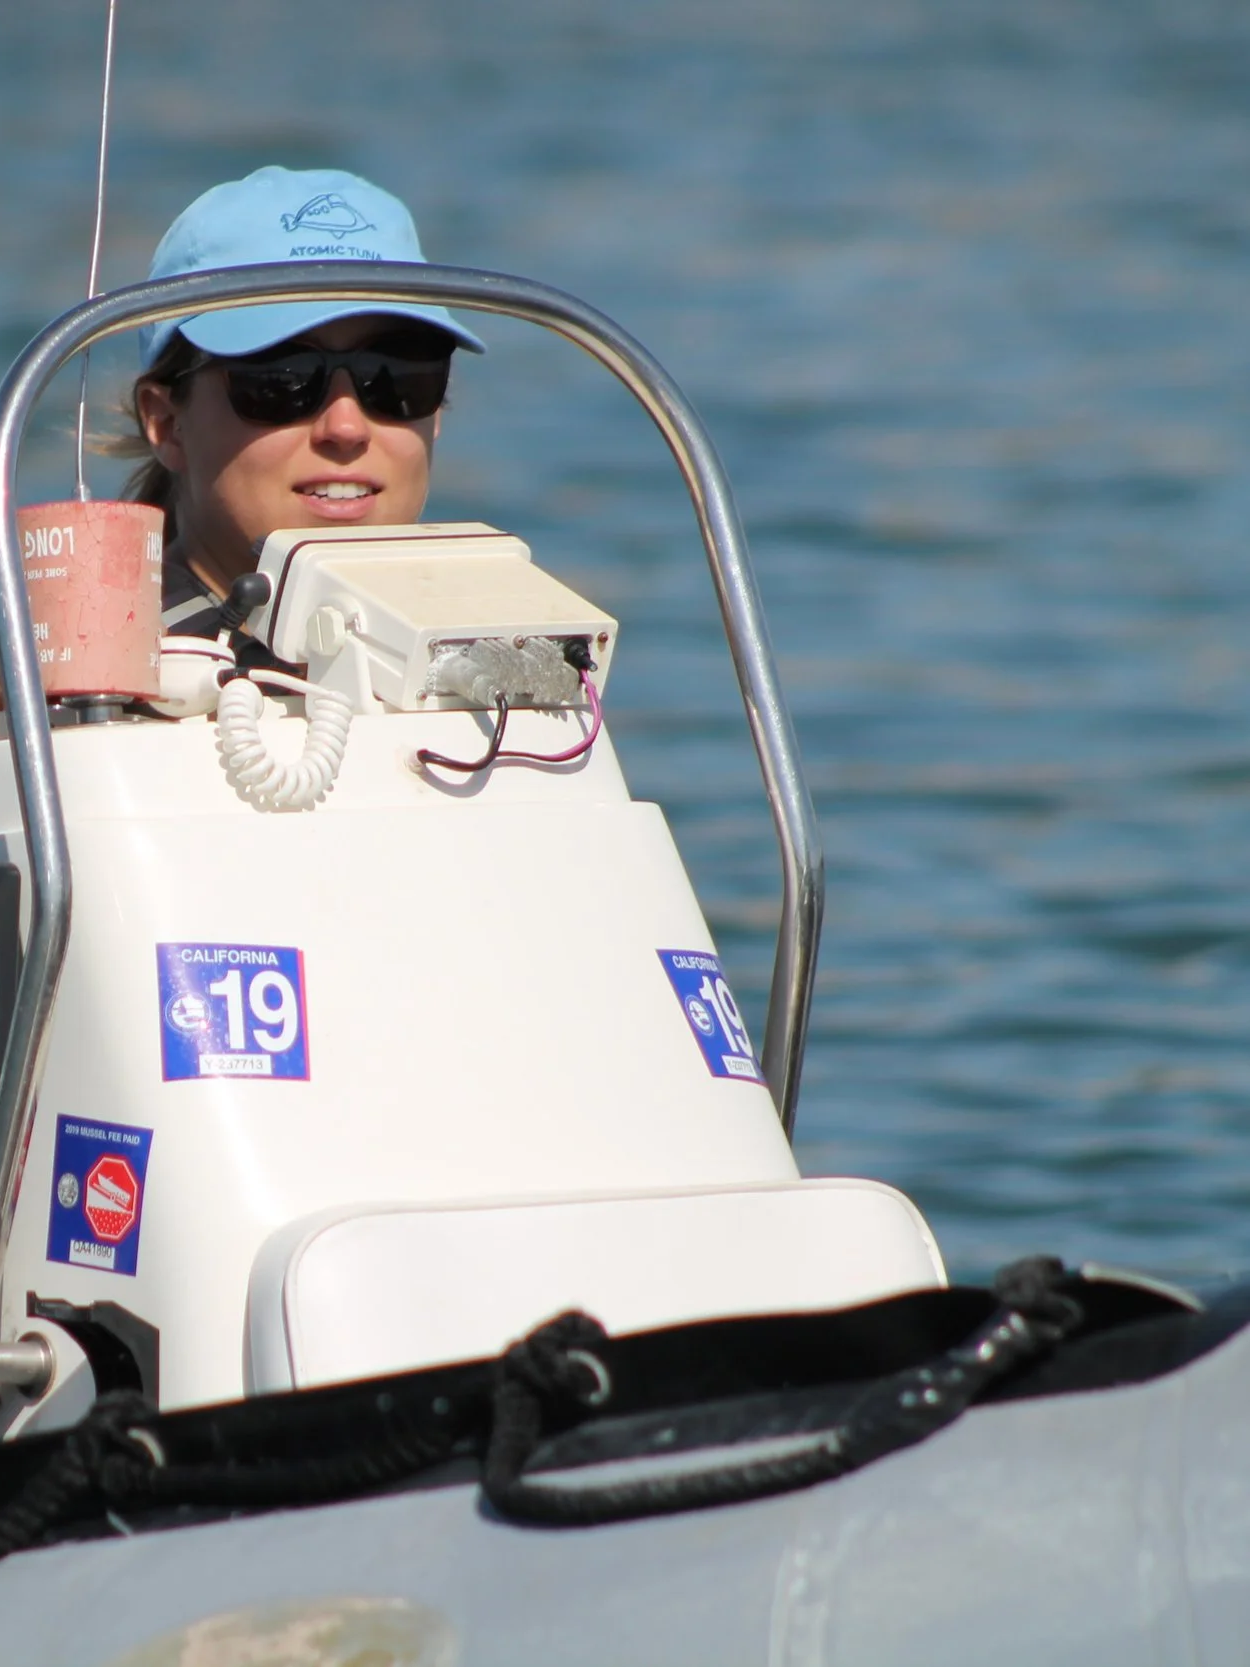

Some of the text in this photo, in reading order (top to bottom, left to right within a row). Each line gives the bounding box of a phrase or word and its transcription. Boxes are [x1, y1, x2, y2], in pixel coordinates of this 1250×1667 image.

[290, 246, 383, 260] ATOMIC TUNA
[25, 526, 74, 559] LONG
[45, 566, 67, 578] SOME
[59, 648, 71, 661] IF
[181, 949, 278, 965] CALIFORNIA
[210, 970, 298, 1052] 19
[699, 976, 753, 1057] 19
[80, 1126, 107, 1141] MUSSEL
[108, 1131, 122, 1143] FEE
[123, 1134, 140, 1145] PAID
